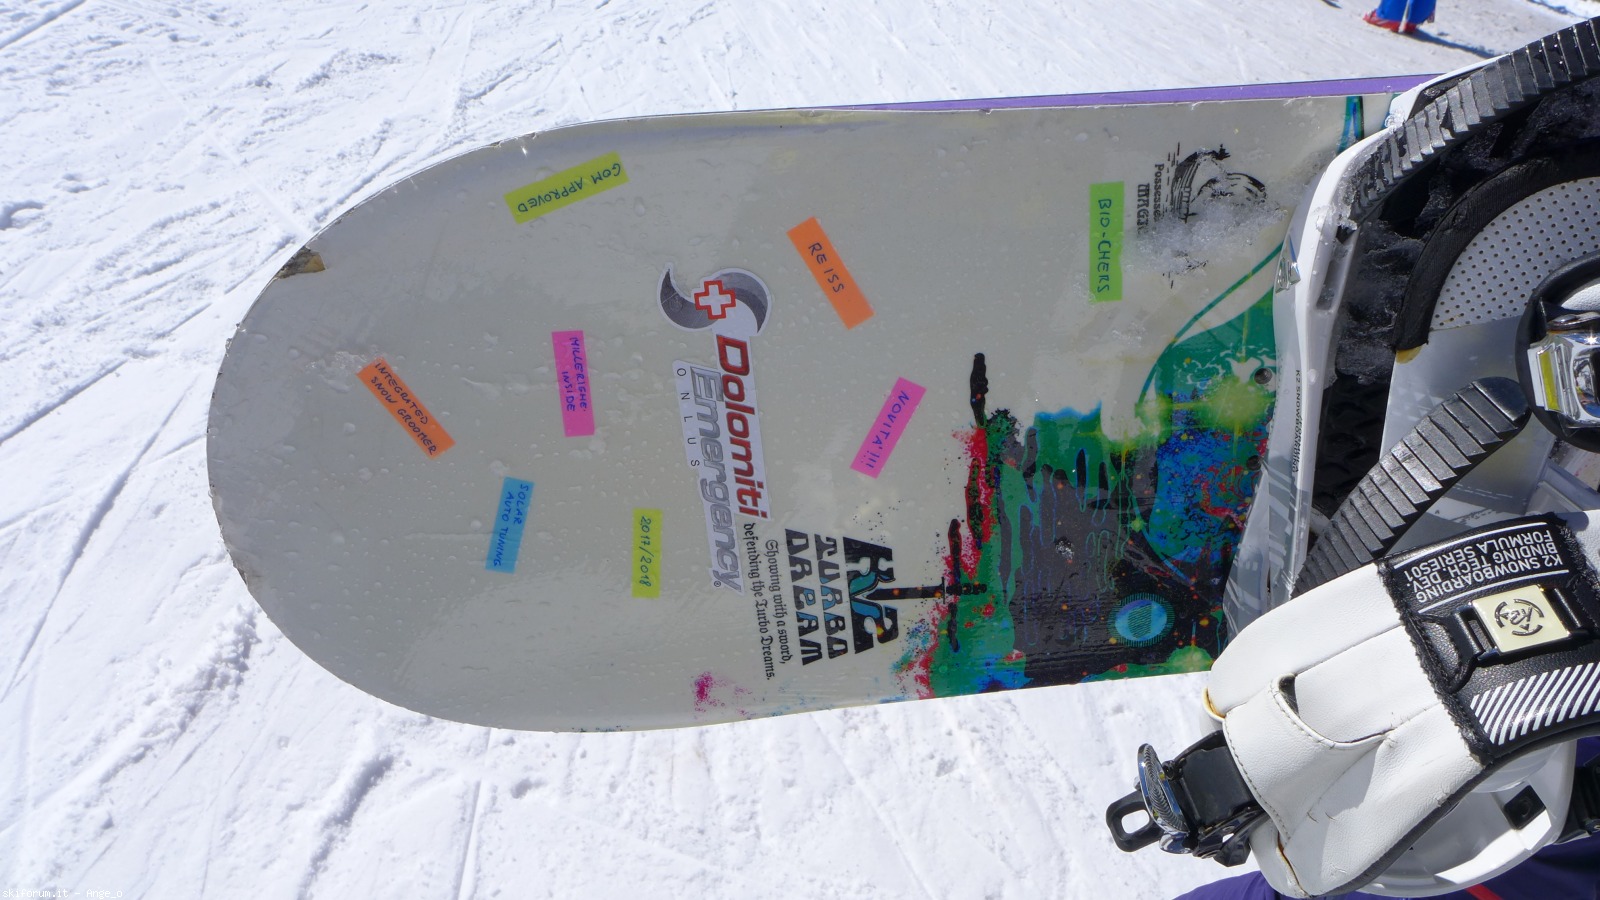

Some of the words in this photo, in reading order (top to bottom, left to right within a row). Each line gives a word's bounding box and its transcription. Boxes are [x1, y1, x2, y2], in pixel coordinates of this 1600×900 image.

[517, 177, 584, 213] APPROVED
[808, 242, 845, 294] REISS
[375, 362, 429, 426] INTEGRATED
[561, 370, 576, 412] INSIDE
[370, 376, 398, 405] SNOW
[397, 408, 437, 456] GROOMER
[676, 366, 701, 468] ONLUS
[715, 333, 769, 520] Dolomiti
[501, 491, 515, 522] AUTO
[513, 483, 529, 526] SOLAR
[493, 526, 509, 567] TUNING
[639, 515, 655, 588] 2017/2018
[743, 522, 762, 579] defending
[1476, 530, 1554, 553] FORMULA
[1493, 541, 1559, 563] BINDING
[1542, 553, 1564, 568] K2
[765, 539, 779, 593] Showing
[1404, 546, 1476, 583] SERIES01
[1406, 572, 1442, 589] DEV.
[1416, 557, 1541, 603] SNOWBOARDING
[1444, 555, 1488, 579] TECH.
[750, 580, 764, 597] the
[773, 594, 787, 619] with
[784, 528, 823, 667] DREAM
[814, 533, 849, 660] TURBO
[754, 599, 770, 634] Turbo
[760, 635, 775, 681] Dreams.
[778, 628, 793, 665] sword,
